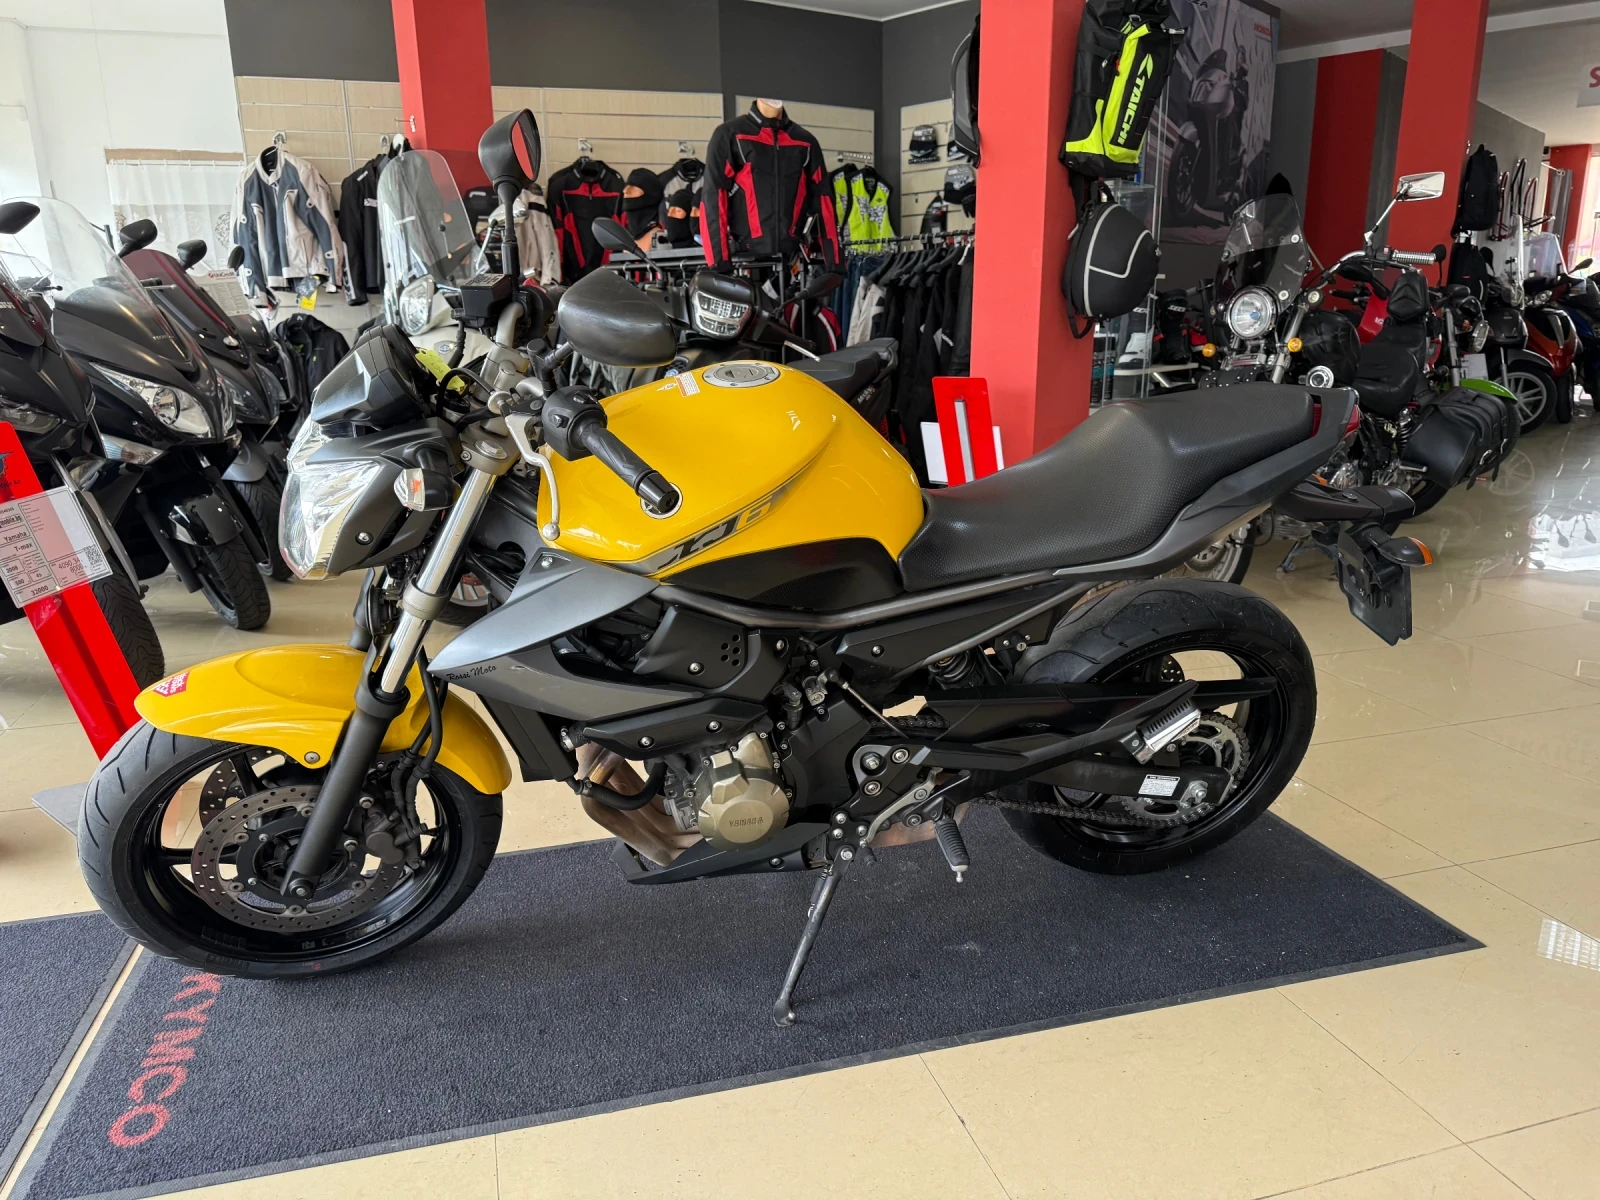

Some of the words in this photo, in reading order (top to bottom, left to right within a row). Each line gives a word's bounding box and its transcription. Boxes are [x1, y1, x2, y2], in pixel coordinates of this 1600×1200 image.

[1117, 75, 1146, 146] TAICHI
[4, 531, 27, 541] Yamaha
[13, 542, 33, 552] T-max
[30, 584, 49, 597] 32000
[446, 671, 471, 681] Rossi
[470, 664, 497, 677] Moto
[728, 816, 765, 828] YAMAHA
[107, 973, 222, 1147] KYMCO
